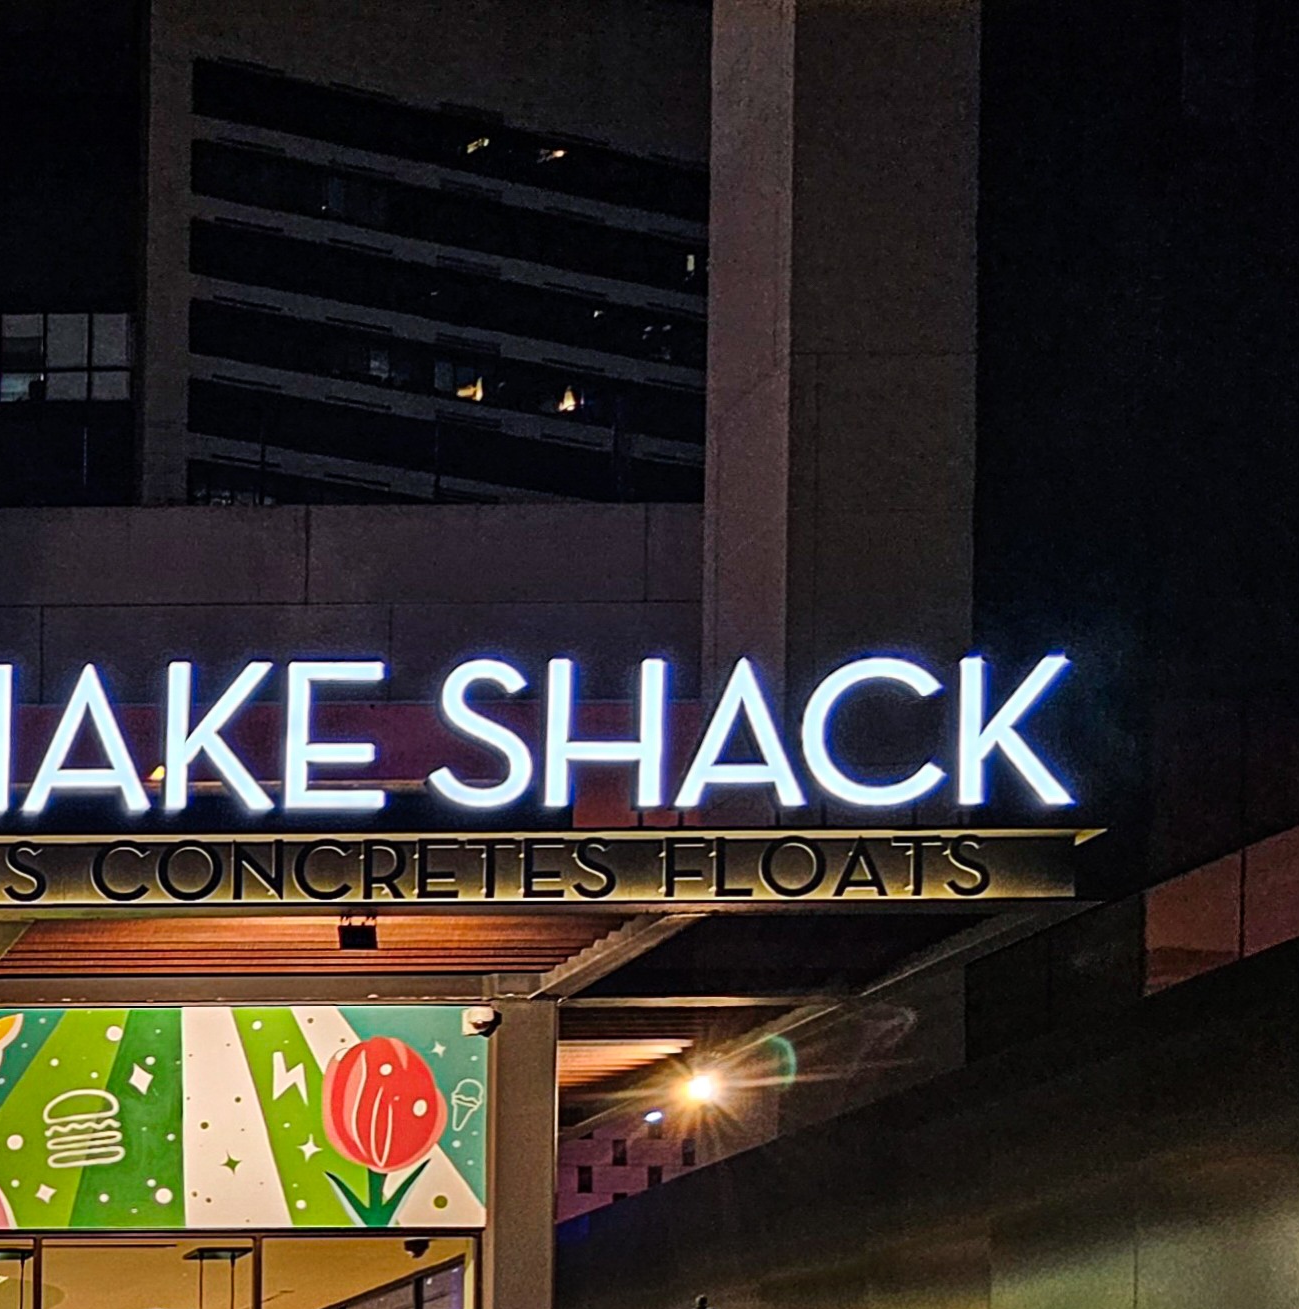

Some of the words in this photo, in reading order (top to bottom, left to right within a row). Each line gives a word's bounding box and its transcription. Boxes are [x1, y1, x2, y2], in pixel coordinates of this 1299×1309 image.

[427, 654, 1076, 808] SHACK
[91, 837, 616, 901] CONCRETES
[661, 835, 992, 899] FLOATS
